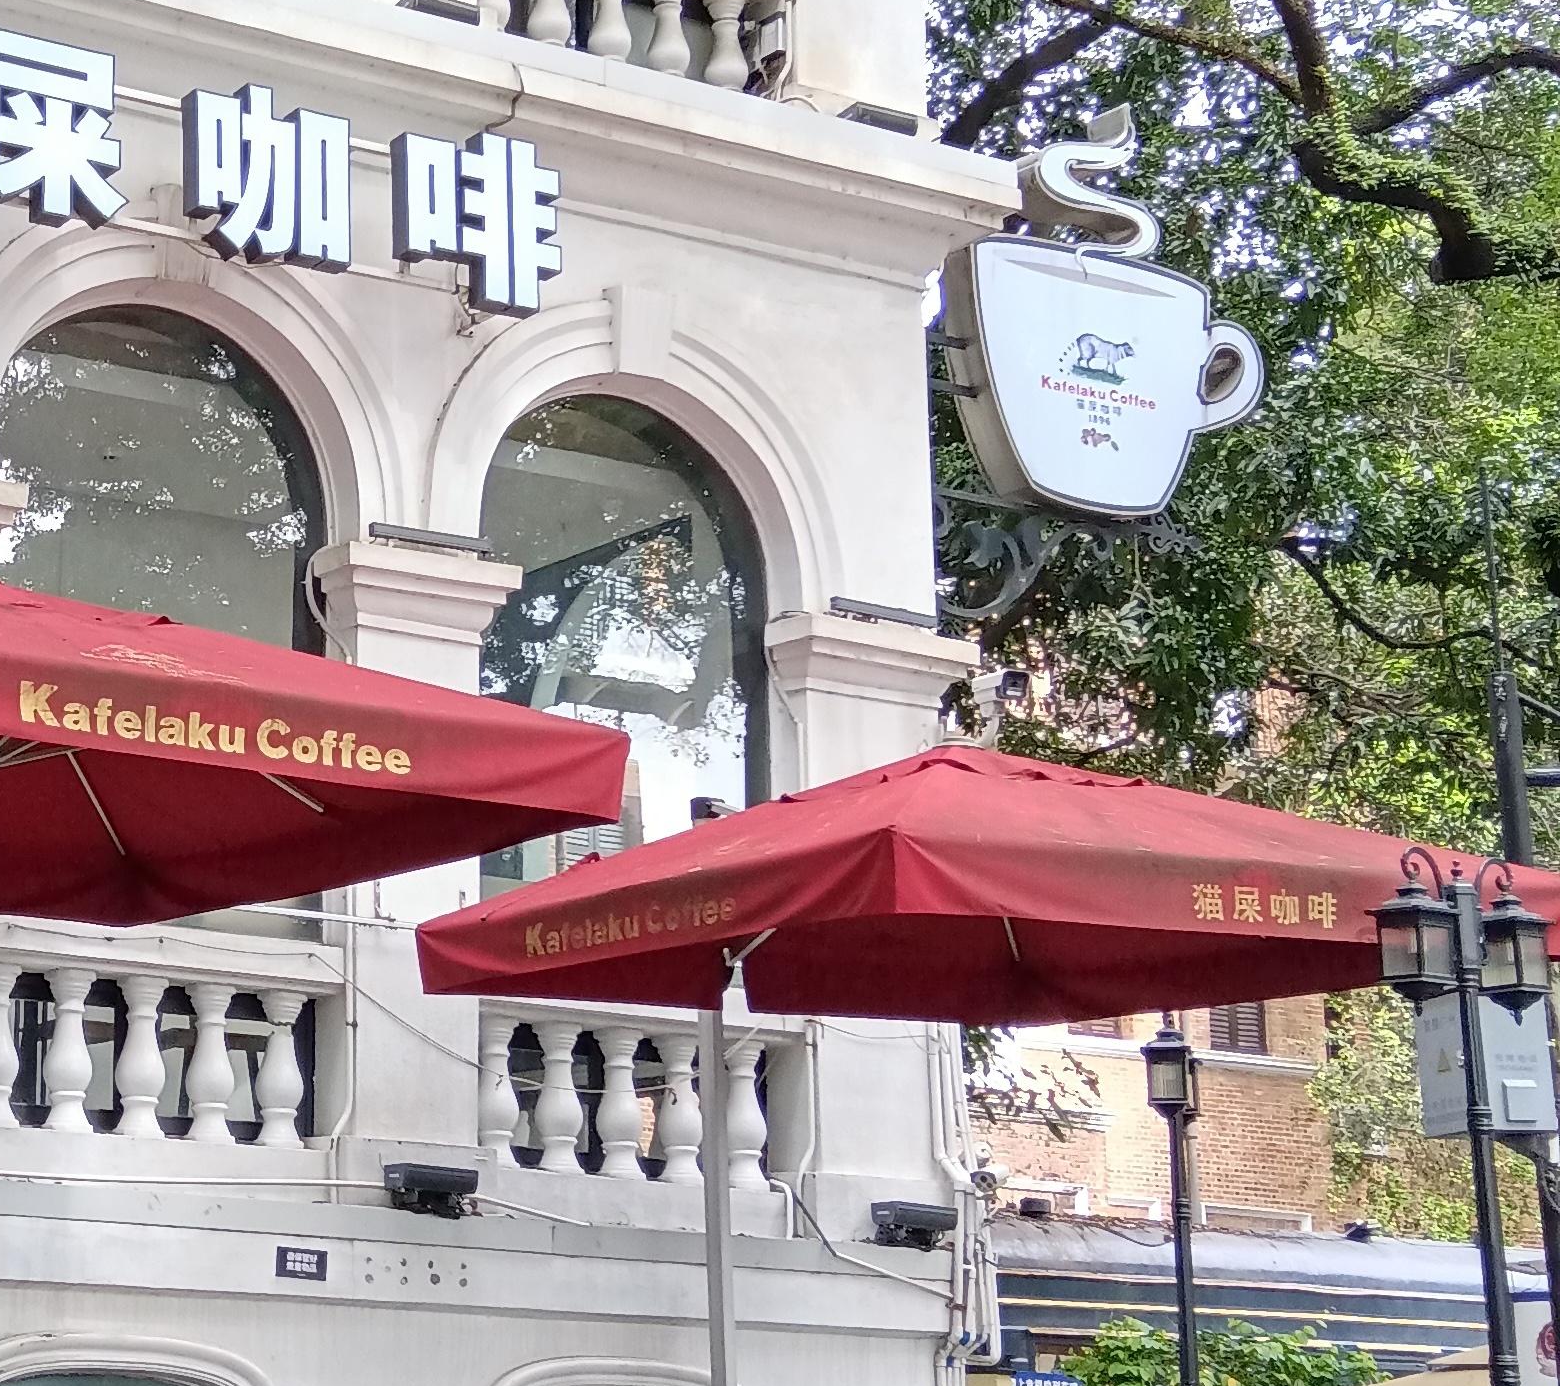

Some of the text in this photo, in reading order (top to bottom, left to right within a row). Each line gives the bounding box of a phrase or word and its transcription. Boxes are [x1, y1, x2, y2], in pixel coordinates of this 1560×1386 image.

[1040, 374, 1157, 410] Kafelaku Coffee
[18, 679, 413, 776] Kafelaku Coffee
[524, 895, 738, 959] Kafelaku Coffee
[1191, 883, 1338, 929] 猫屎咖啡
